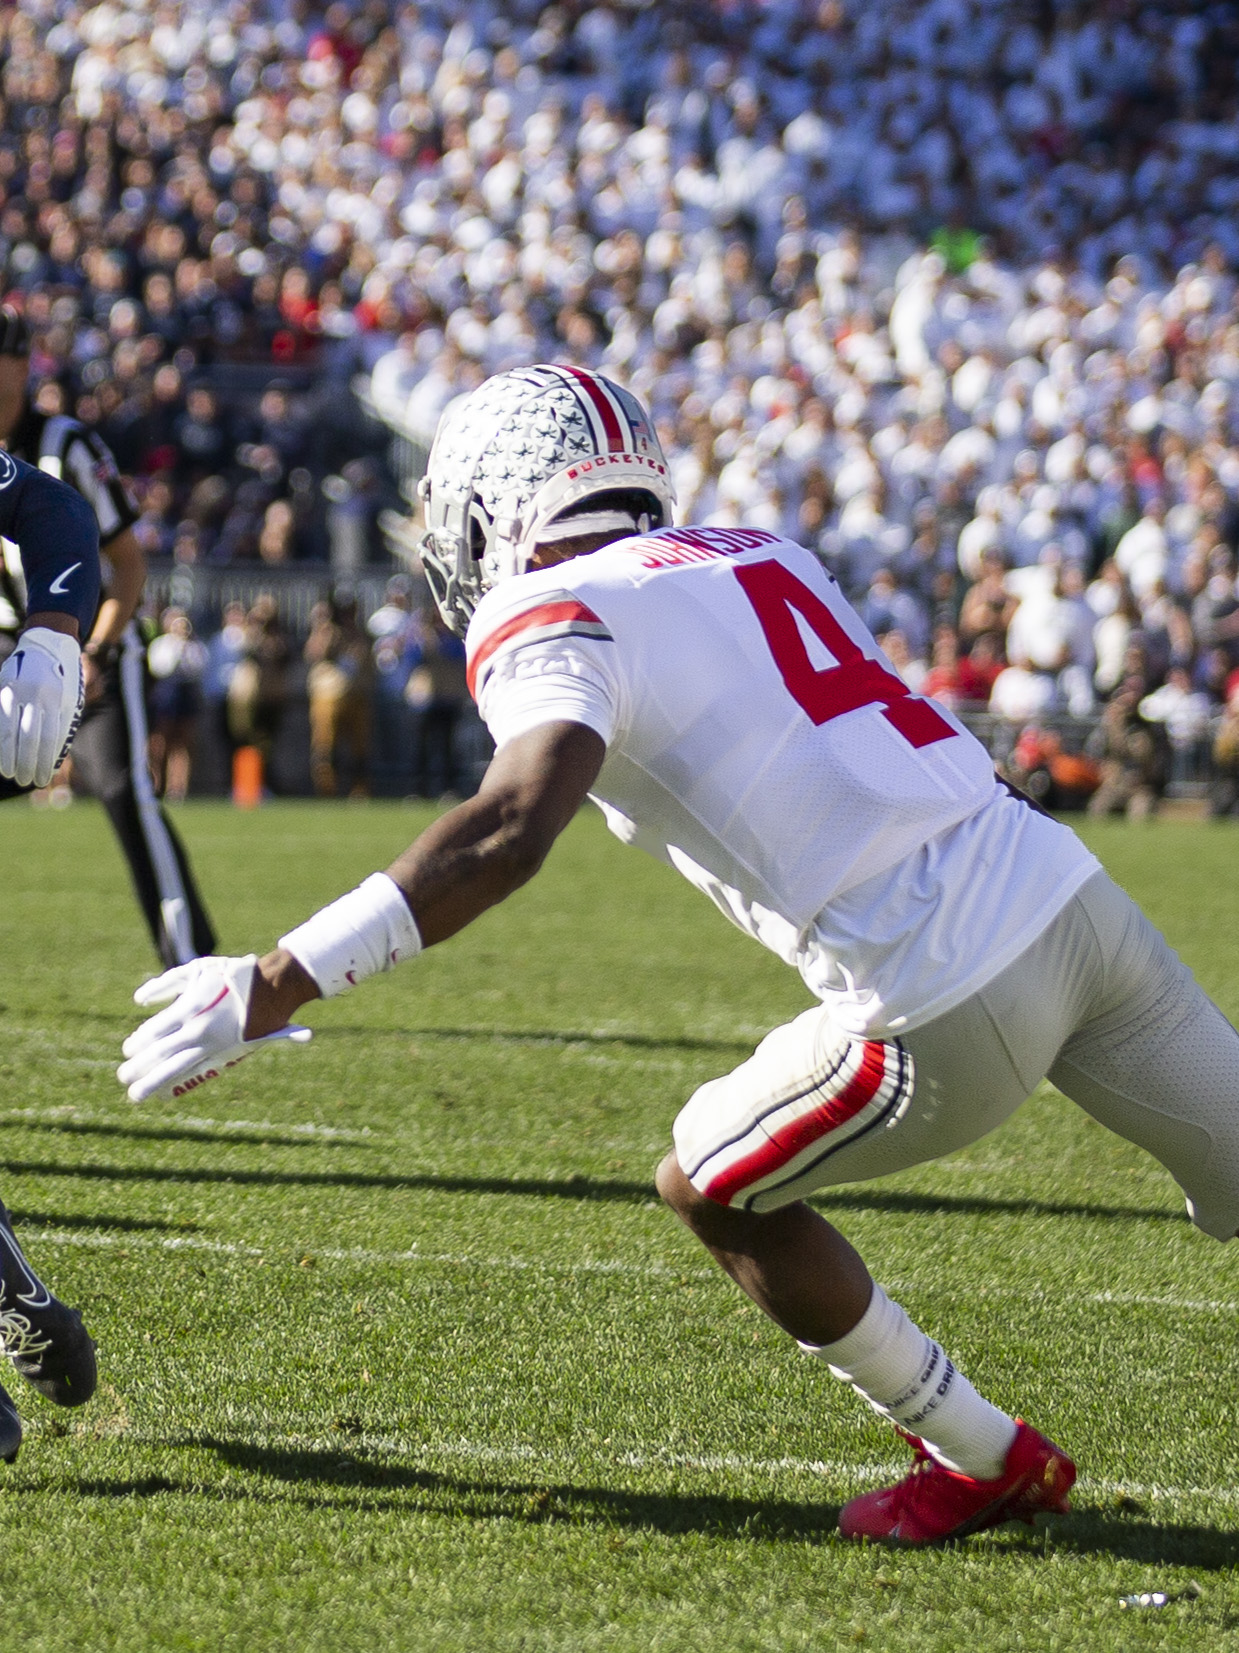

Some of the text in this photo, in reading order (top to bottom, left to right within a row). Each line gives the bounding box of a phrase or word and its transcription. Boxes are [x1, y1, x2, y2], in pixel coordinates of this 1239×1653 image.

[567, 454, 665, 479] BUCKEYES
[628, 527, 783, 569] JOHNSON
[733, 558, 959, 749] 4
[904, 1396, 938, 1425] NIKE
